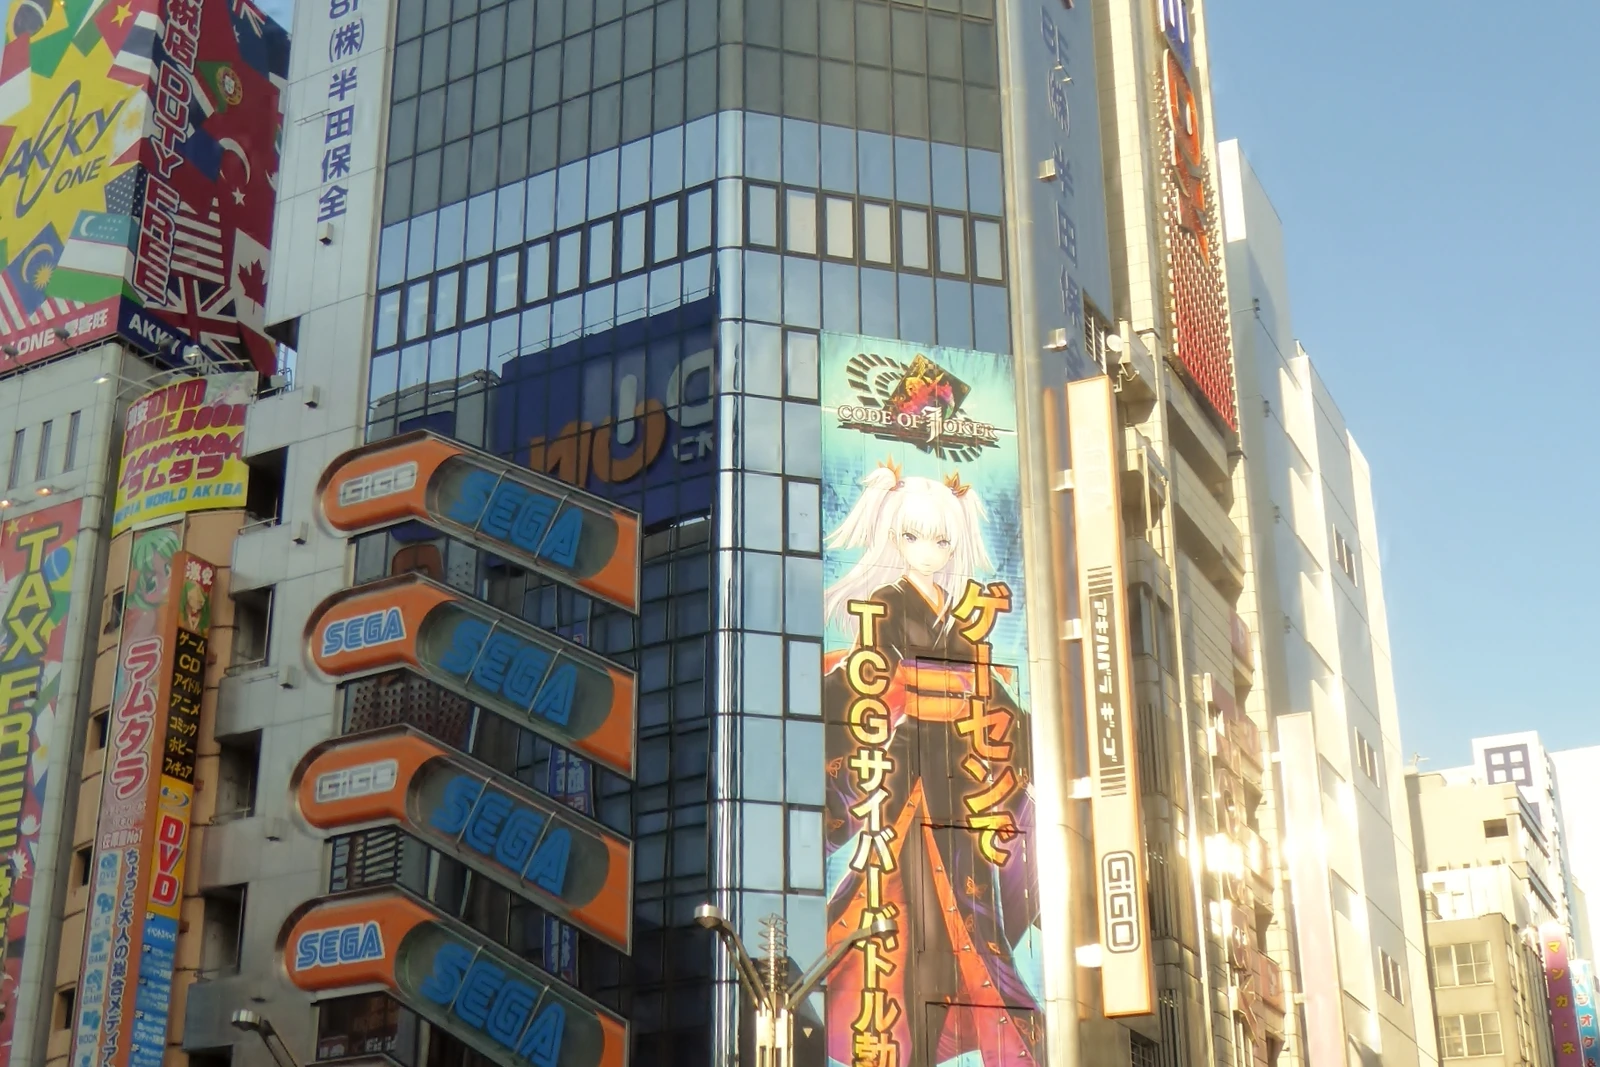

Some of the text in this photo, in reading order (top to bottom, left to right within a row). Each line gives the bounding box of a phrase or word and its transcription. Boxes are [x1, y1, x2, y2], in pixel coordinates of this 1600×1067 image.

[148, 60, 192, 180] DUTY
[54, 155, 106, 194] ONE
[133, 173, 181, 306] FREE
[17, 328, 55, 360] ONE
[148, 378, 207, 418] DVD
[838, 404, 999, 443] CODE OF JOKER
[127, 454, 224, 500] ラムタラ
[145, 488, 187, 509] WORLD
[192, 482, 243, 498] AKIBA
[449, 470, 583, 568] SEGA
[2, 526, 59, 662] TAX
[179, 631, 205, 655] ゲーム
[321, 607, 405, 656] SEGA
[174, 672, 201, 695] アイドル
[179, 653, 201, 673] CD
[440, 619, 578, 727] SEGA
[112, 637, 163, 798] ラムタラ
[169, 715, 197, 737] コミック
[170, 693, 200, 715] アニメ
[952, 579, 1018, 867] ゲーセンで
[165, 757, 193, 778] フィギュア
[169, 736, 194, 756] ホビー
[316, 759, 398, 804] GiGO
[429, 775, 572, 896] SEGA
[152, 815, 185, 906] DVD
[102, 849, 138, 1067] ちょっと大人の総合メディア
[296, 922, 384, 970] SEGA
[420, 942, 566, 1067] SEGA
